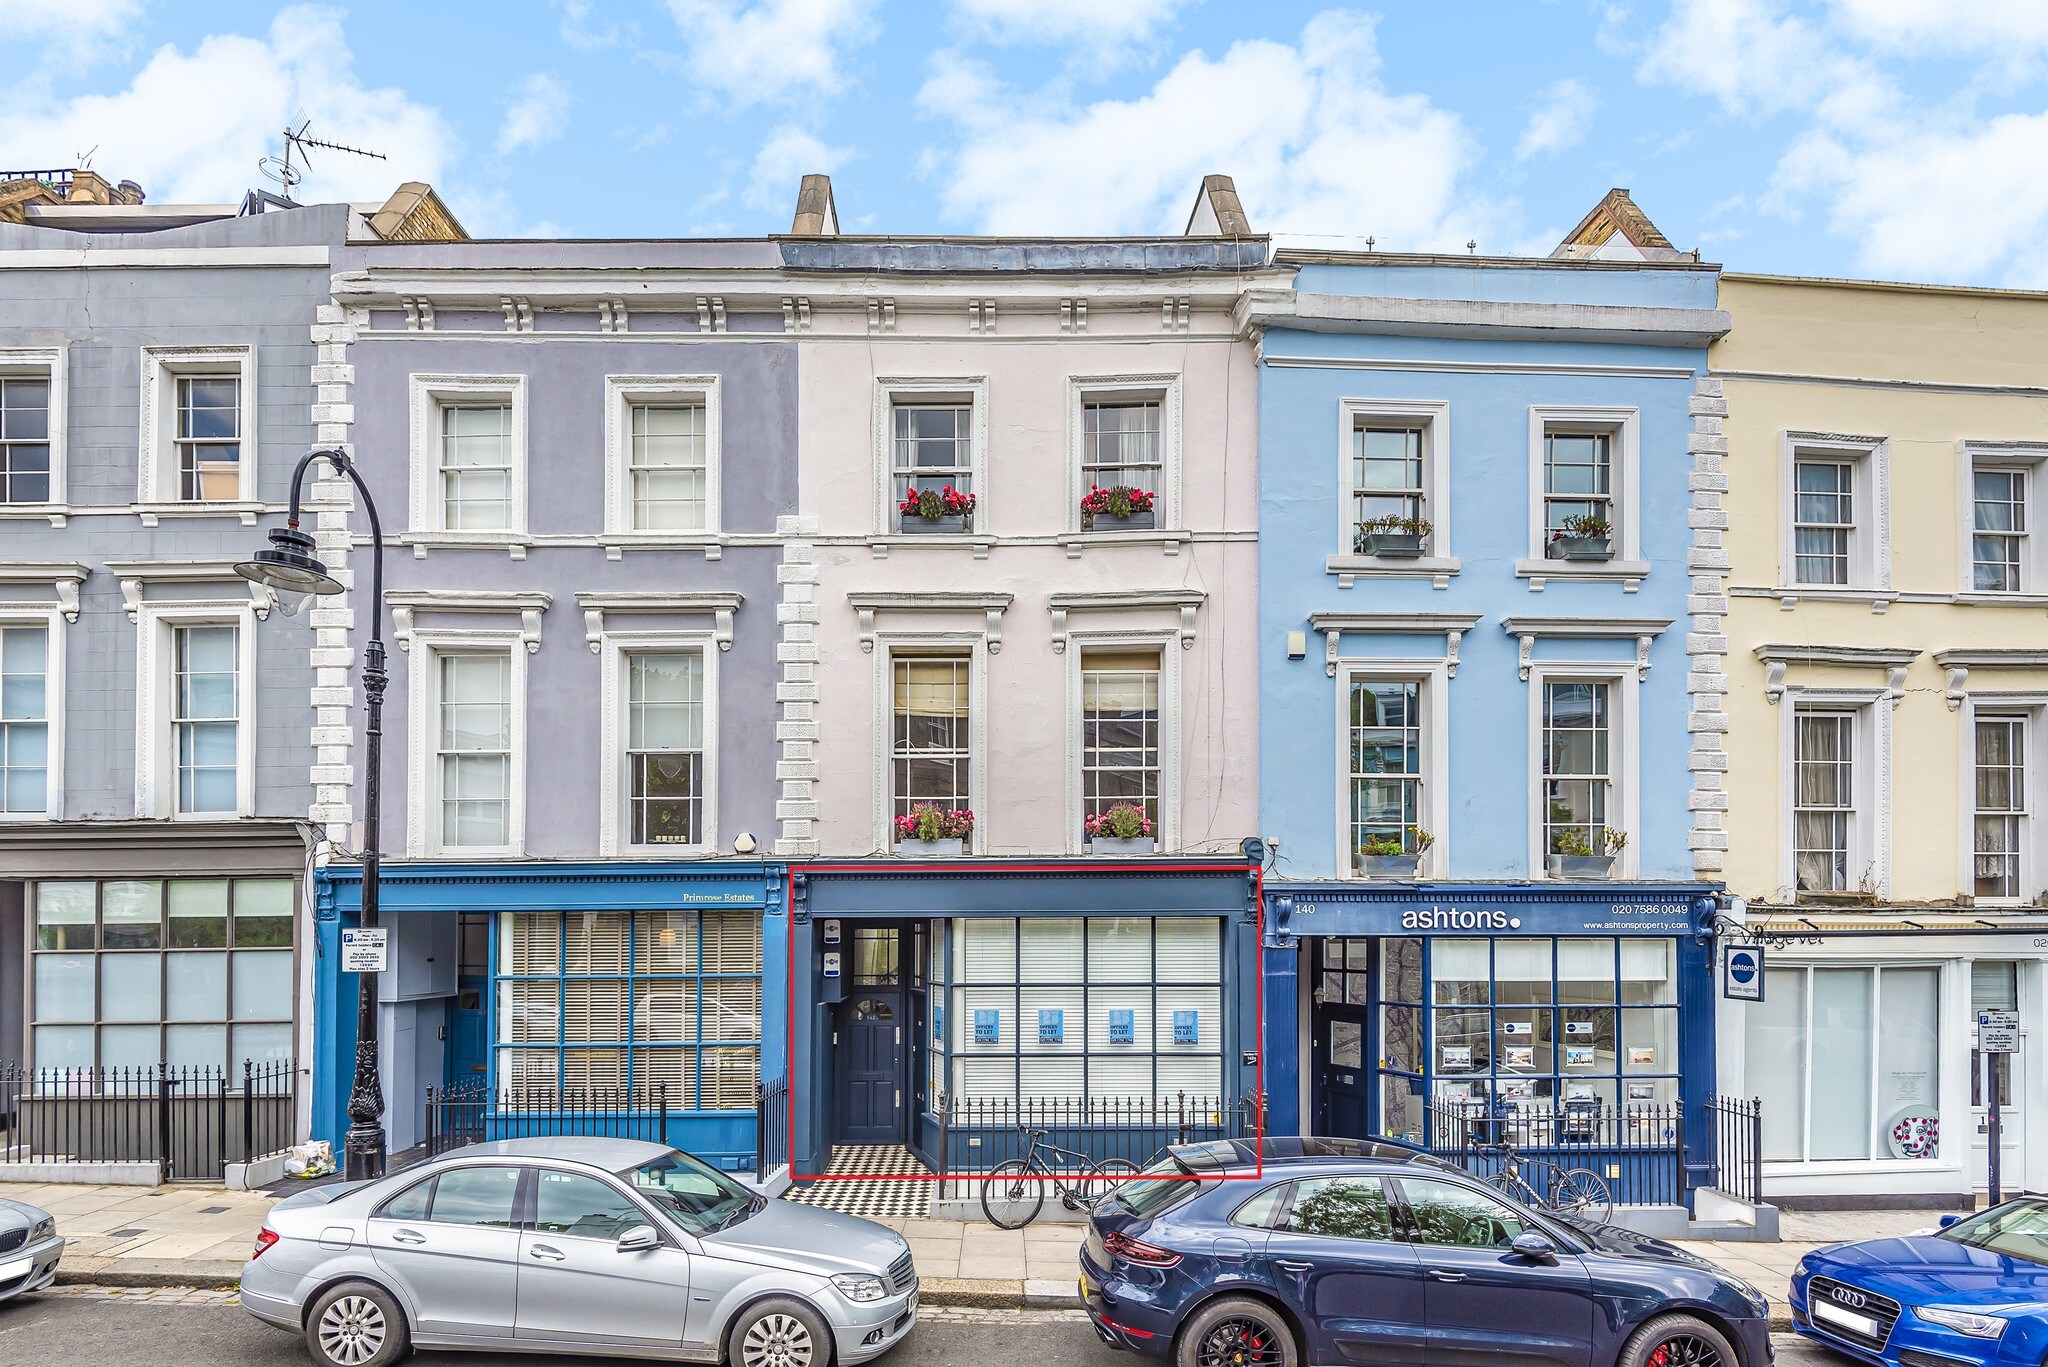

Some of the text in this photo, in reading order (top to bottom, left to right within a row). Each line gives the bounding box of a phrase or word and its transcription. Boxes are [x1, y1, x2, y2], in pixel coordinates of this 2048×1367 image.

[683, 893, 755, 902] Primrose Estates
[1294, 904, 1315, 914] 140
[1611, 905, 1688, 914] 020 7586 0049
[1583, 922, 1689, 930] www.ashtonsproperty.com
[2033, 938, 2048, 948] 02
